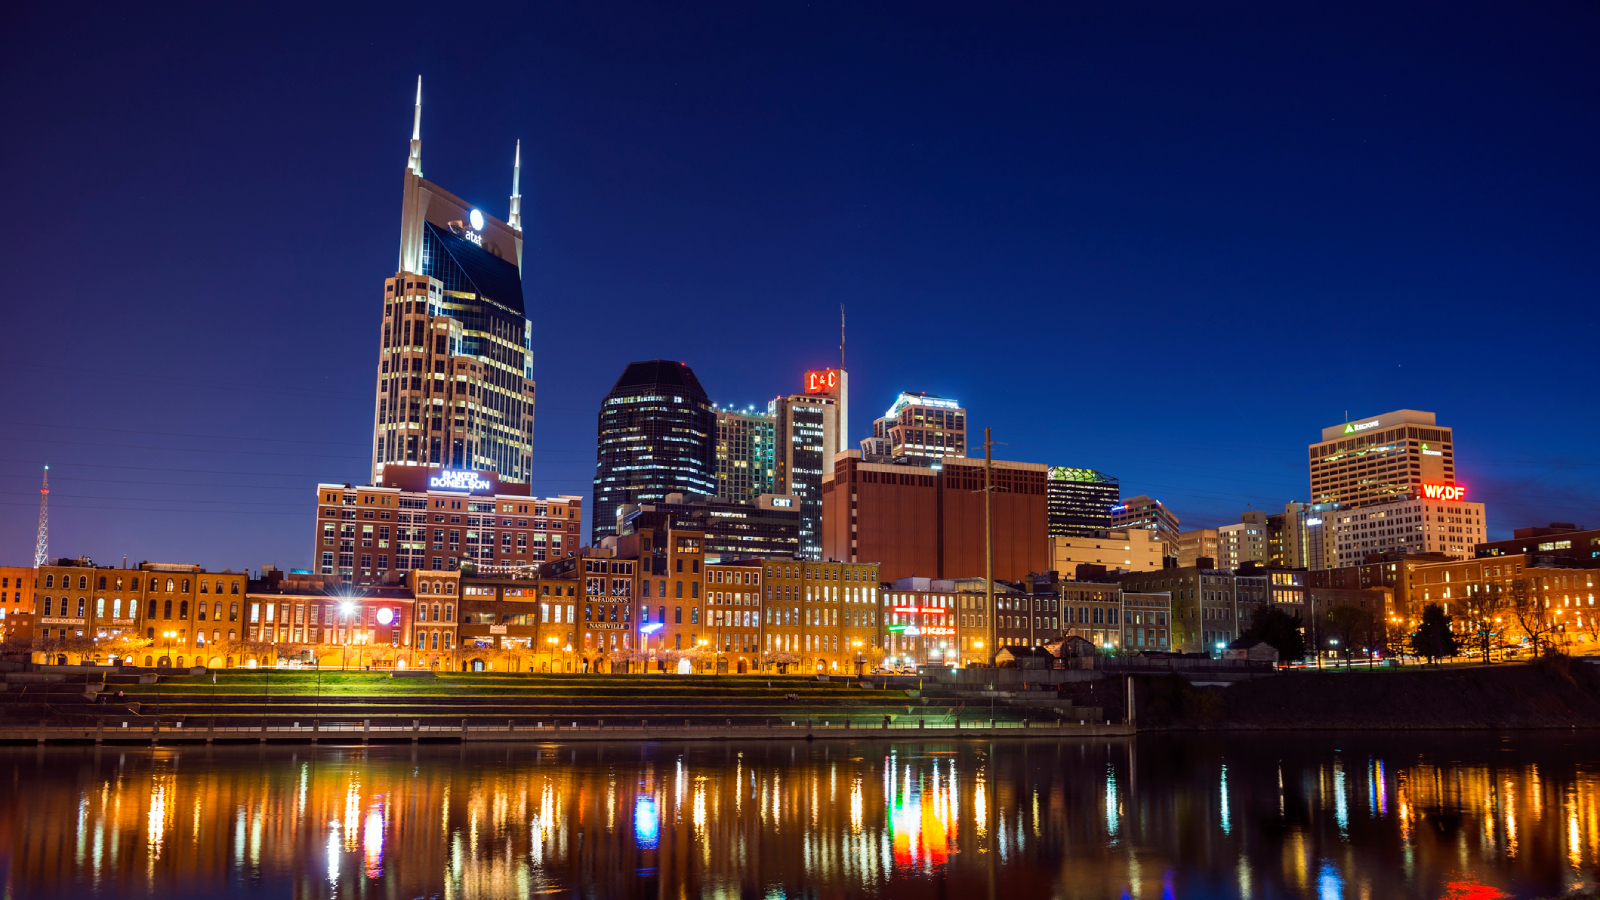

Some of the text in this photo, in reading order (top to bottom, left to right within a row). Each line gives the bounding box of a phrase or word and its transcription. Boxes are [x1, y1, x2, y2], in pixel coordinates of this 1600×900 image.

[442, 470, 479, 481] BAKER
[430, 477, 490, 490] DONELSON
[1423, 483, 1465, 500] WKDF
[773, 498, 791, 507] CMT
